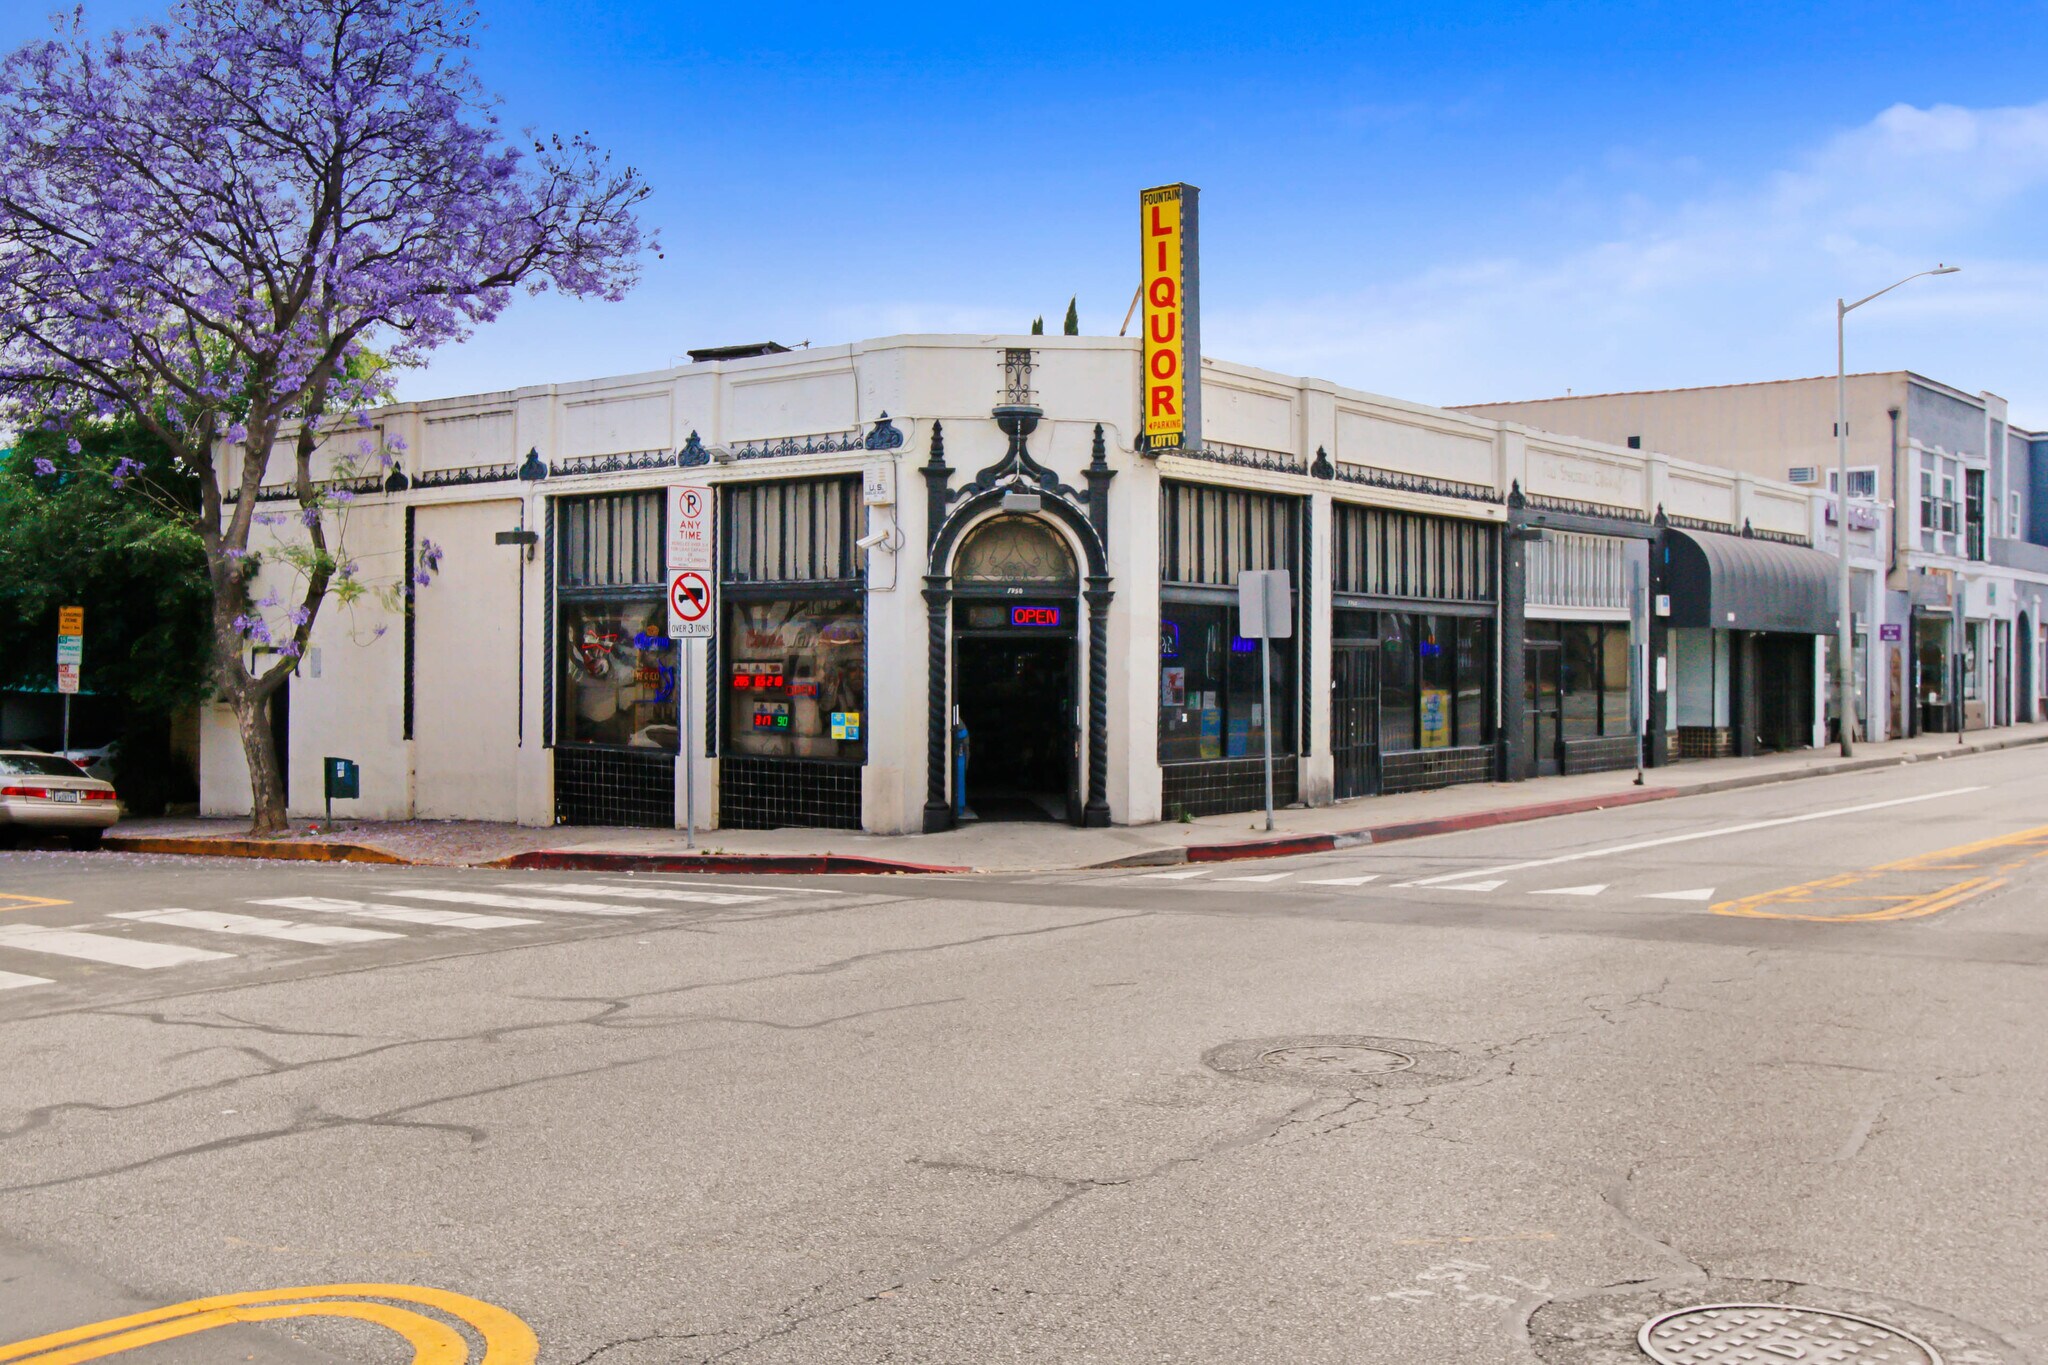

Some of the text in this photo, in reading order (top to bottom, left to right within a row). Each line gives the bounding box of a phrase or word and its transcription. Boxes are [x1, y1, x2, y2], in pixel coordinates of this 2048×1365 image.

[1143, 188, 1180, 205] FOUNTAIN
[1149, 206, 1177, 417] LIQUOR
[1152, 419, 1181, 430] PARKING
[1150, 434, 1179, 448] LOTTO
[680, 520, 701, 530] ANY
[680, 530, 702, 541] TIME
[1014, 609, 1057, 624] OPEN
[671, 623, 710, 634] OVER 3 TONS
[777, 716, 788, 727] 90
